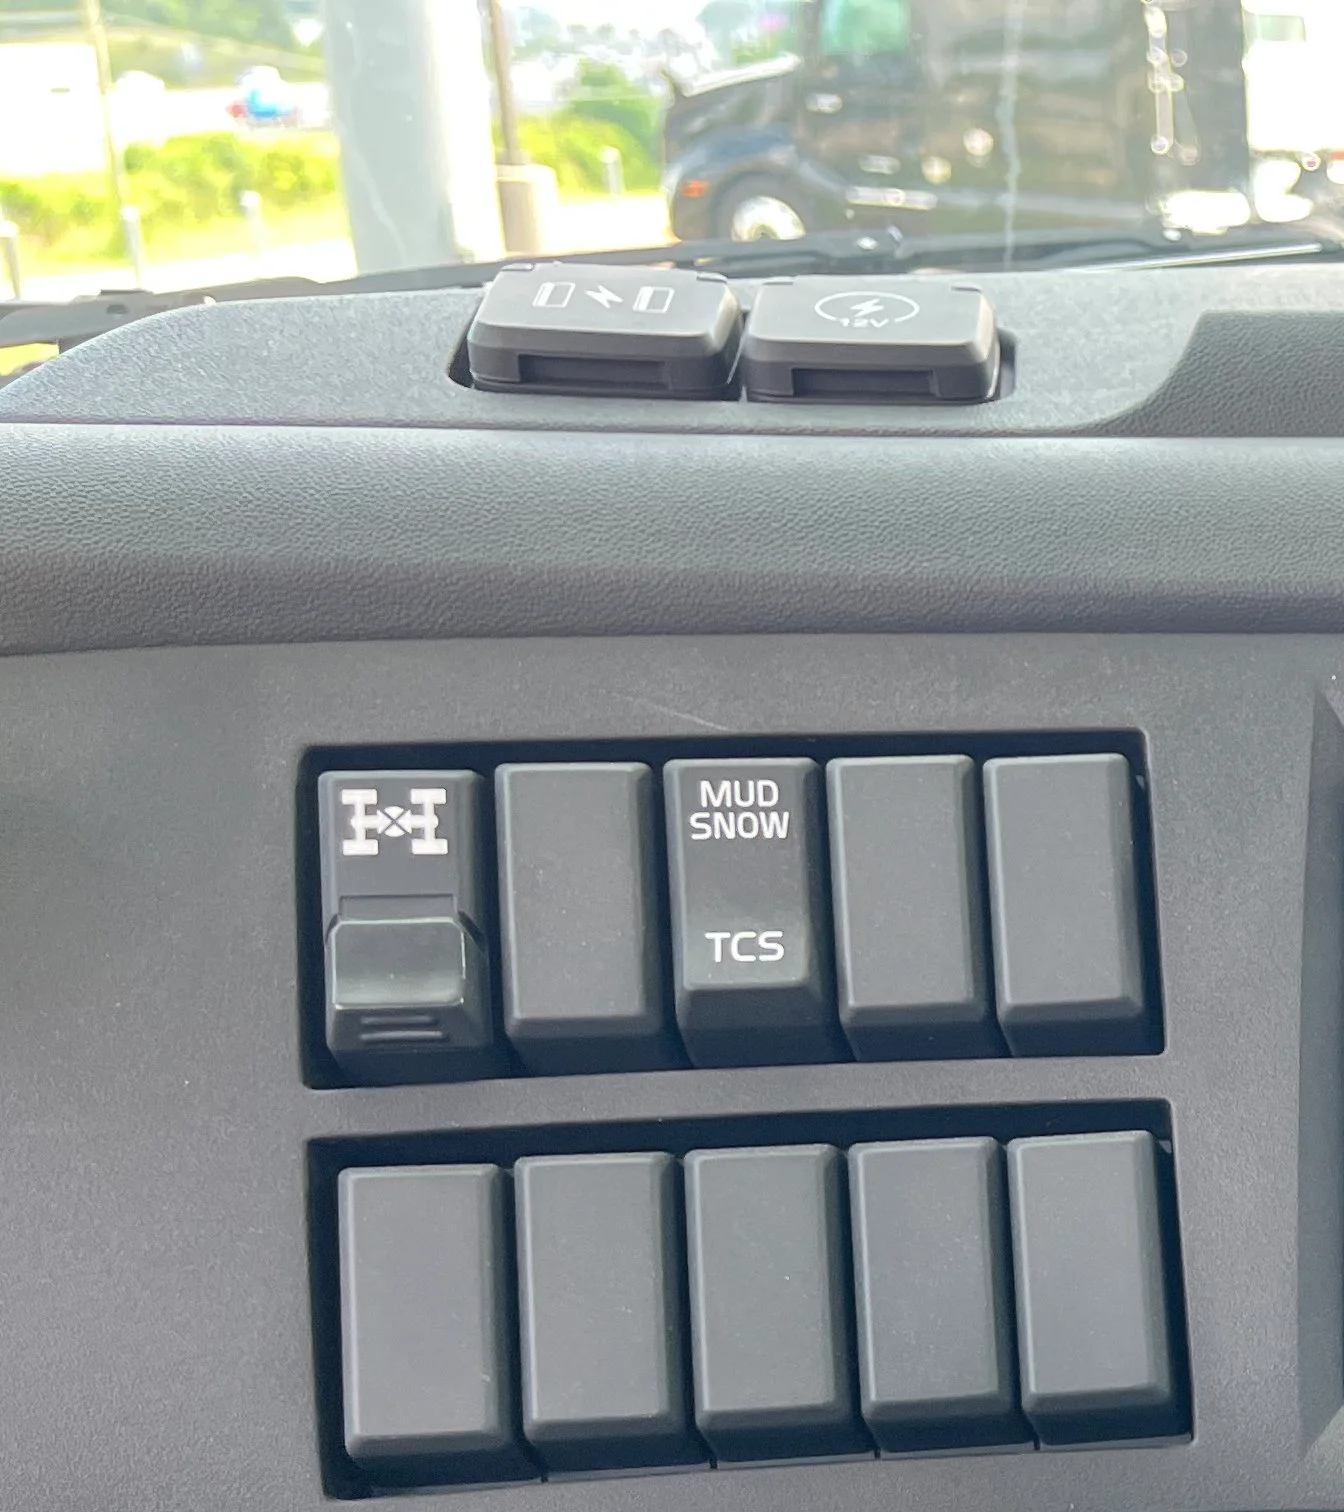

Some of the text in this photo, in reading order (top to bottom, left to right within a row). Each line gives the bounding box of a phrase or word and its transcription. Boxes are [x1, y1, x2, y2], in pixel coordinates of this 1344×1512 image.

[840, 318, 889, 328] 12V
[700, 780, 779, 808] MUD
[689, 811, 790, 840] SNOW
[704, 931, 785, 962] TCS
